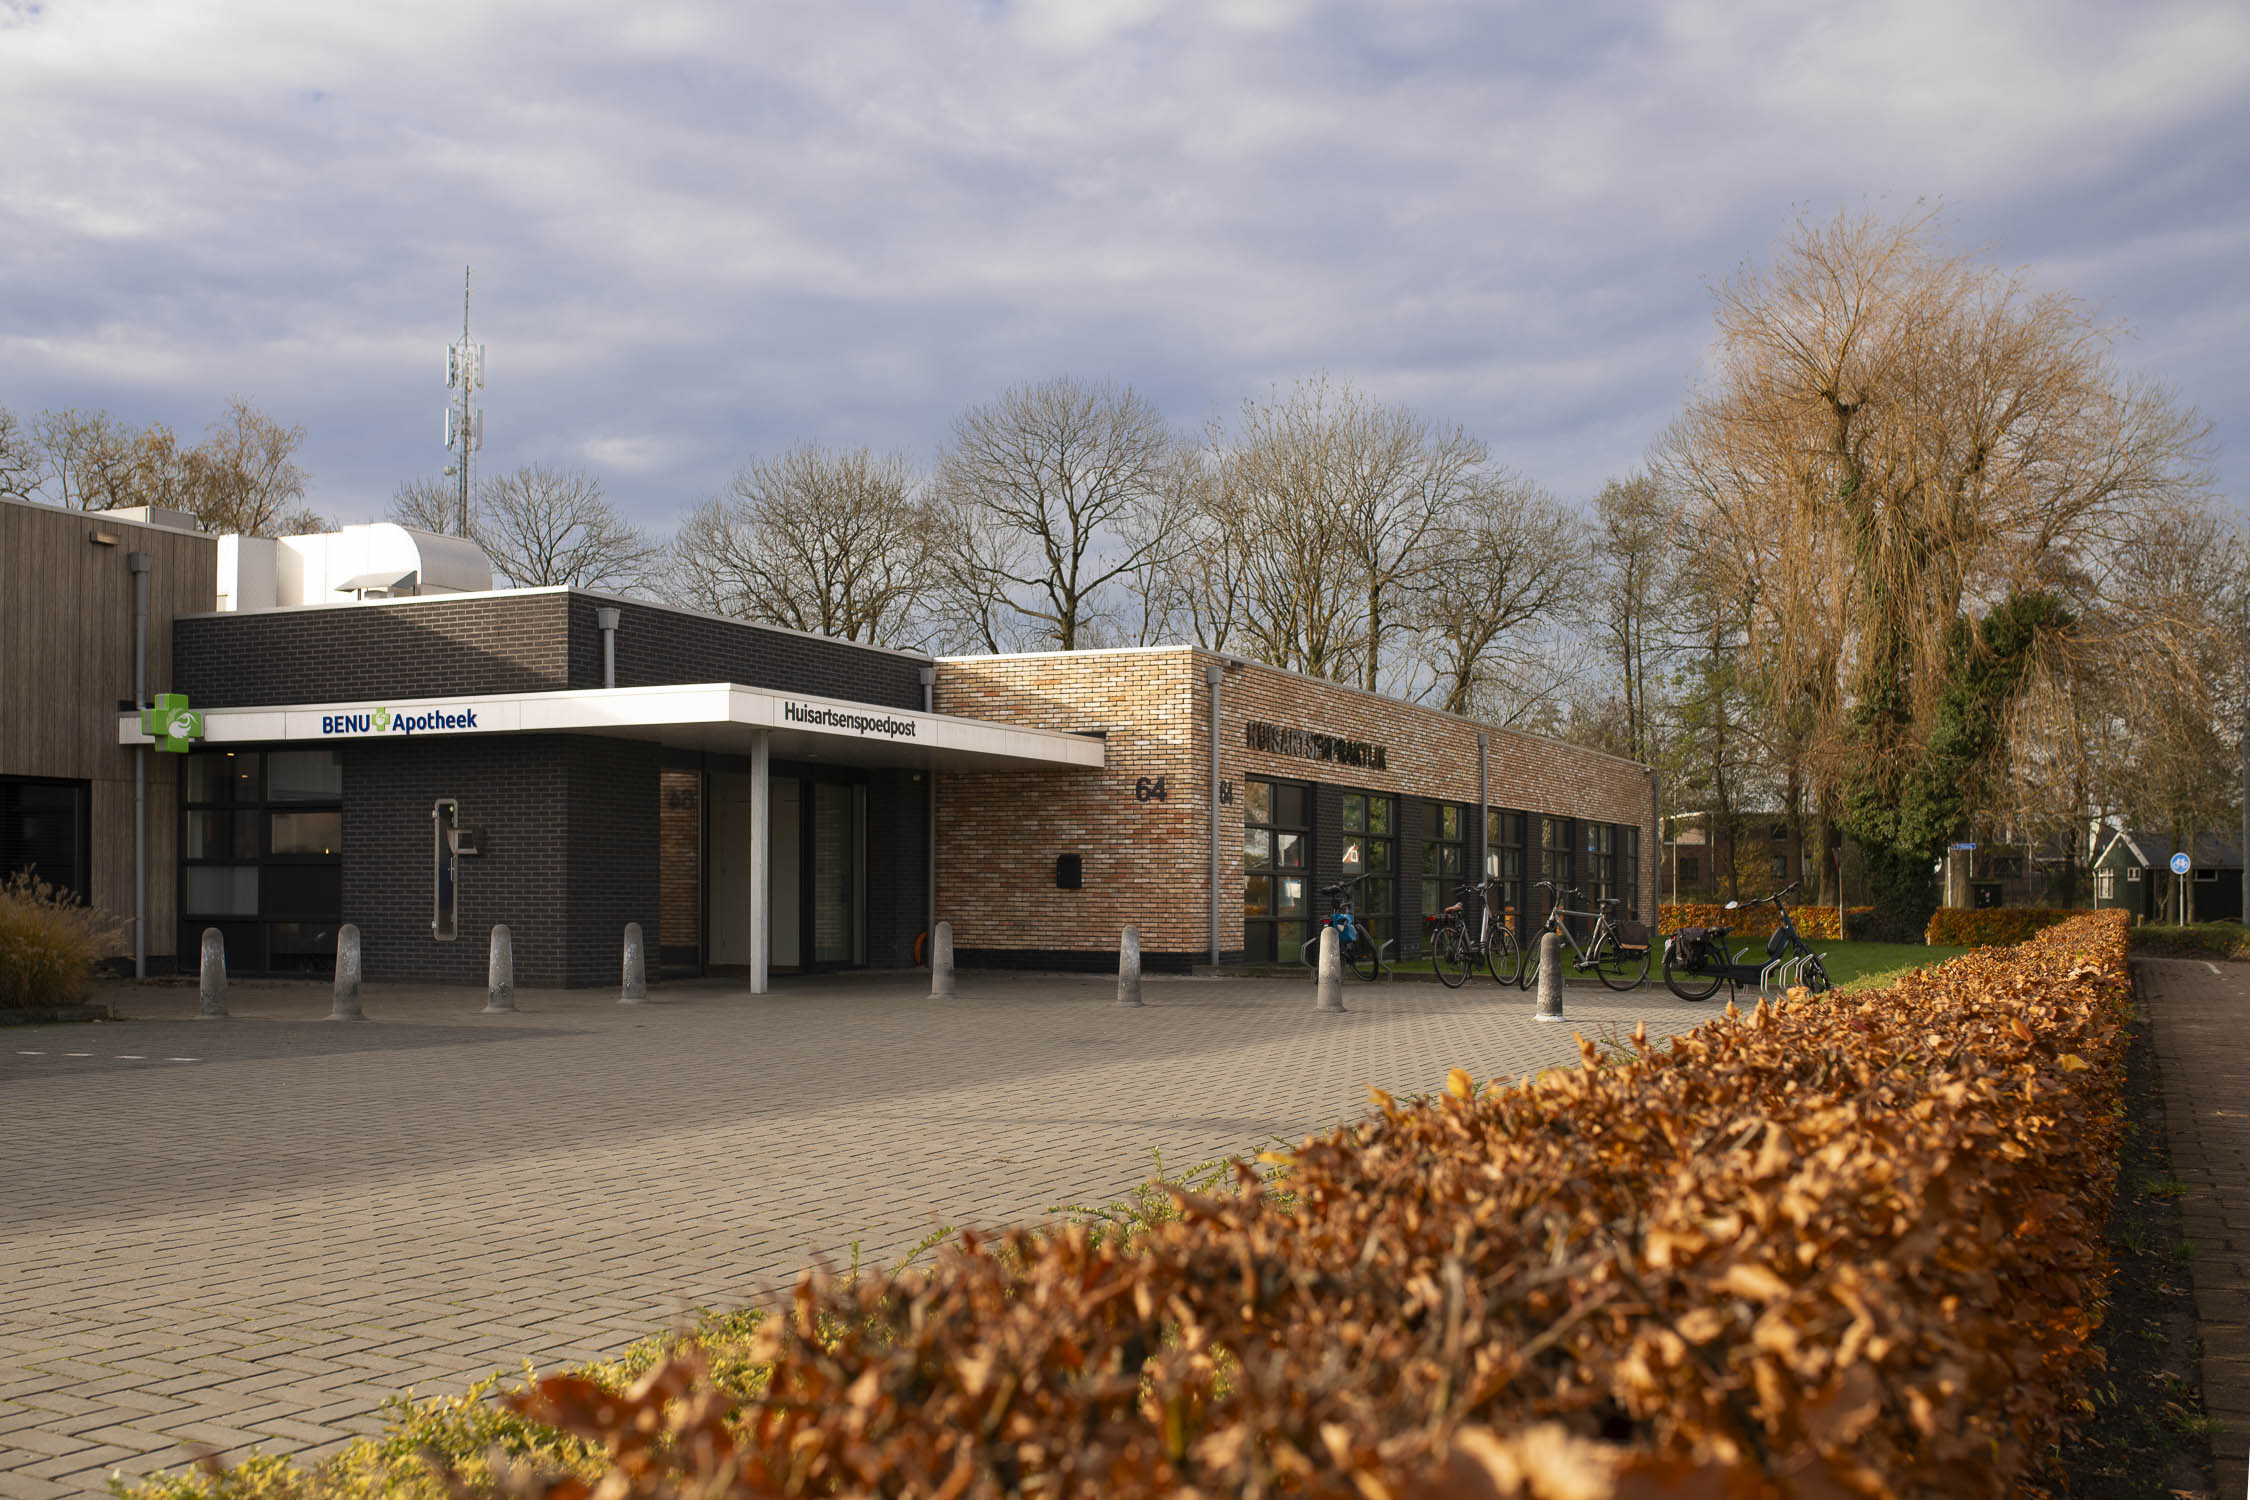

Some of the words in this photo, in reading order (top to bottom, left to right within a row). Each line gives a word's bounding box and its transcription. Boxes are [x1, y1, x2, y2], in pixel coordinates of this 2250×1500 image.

[322, 714, 370, 734] BENU
[392, 708, 478, 735] Apotheek
[785, 702, 916, 738] Huisartsenspoedpost
[1136, 776, 1167, 802] 64
[1220, 779, 1233, 806] 64
